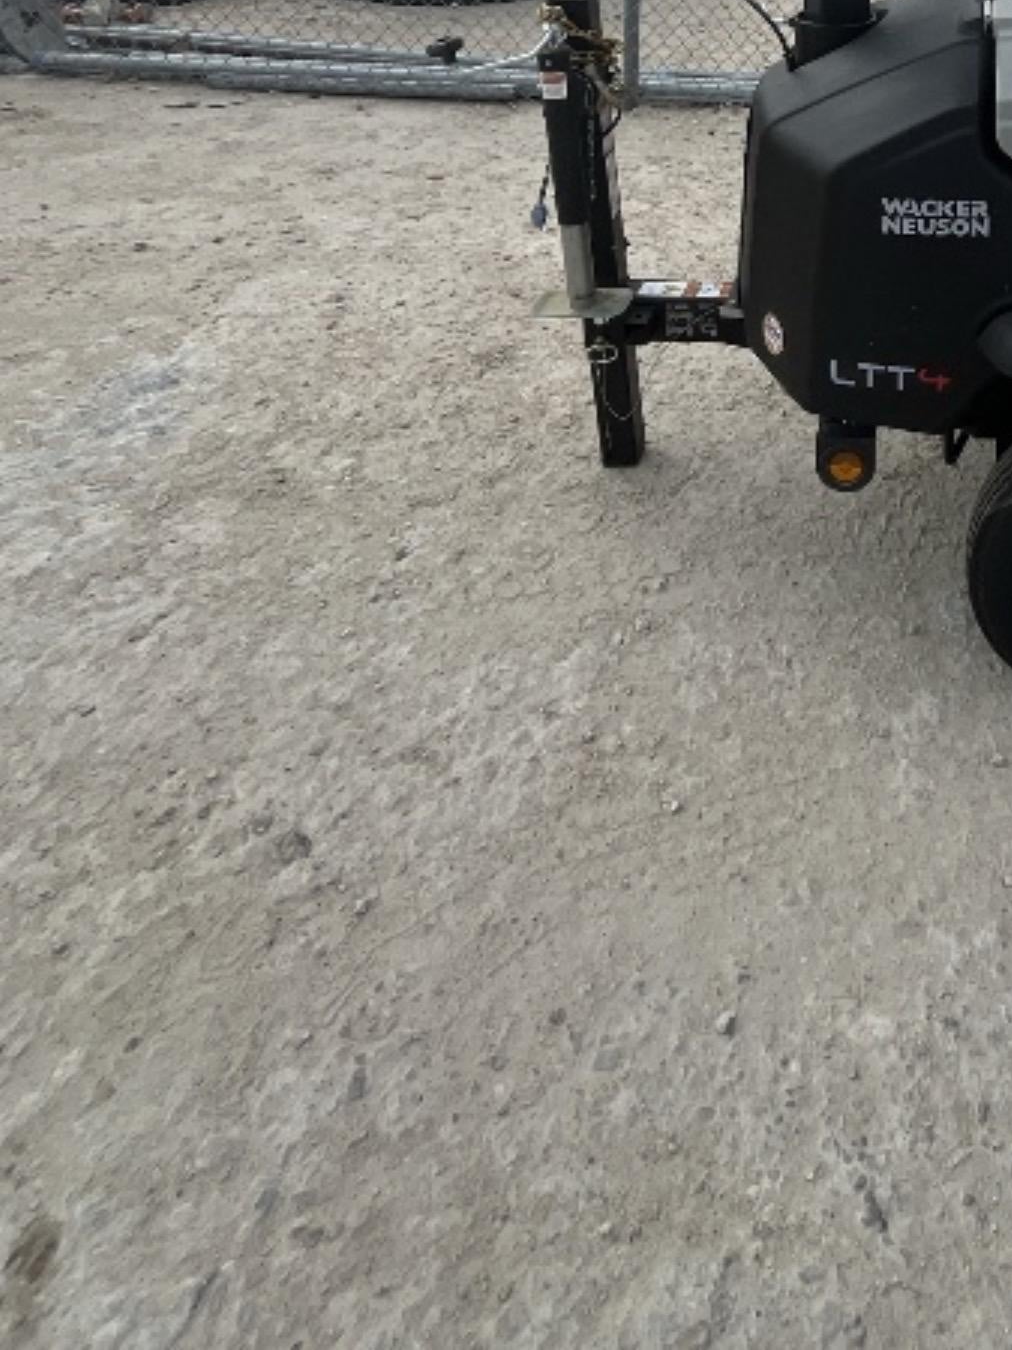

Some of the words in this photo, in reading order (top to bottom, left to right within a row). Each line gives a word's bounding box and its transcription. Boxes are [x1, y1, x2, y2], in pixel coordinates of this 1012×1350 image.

[881, 197, 988, 217] WACKER
[881, 216, 990, 237] NEUSON
[829, 359, 951, 392] LTT4
